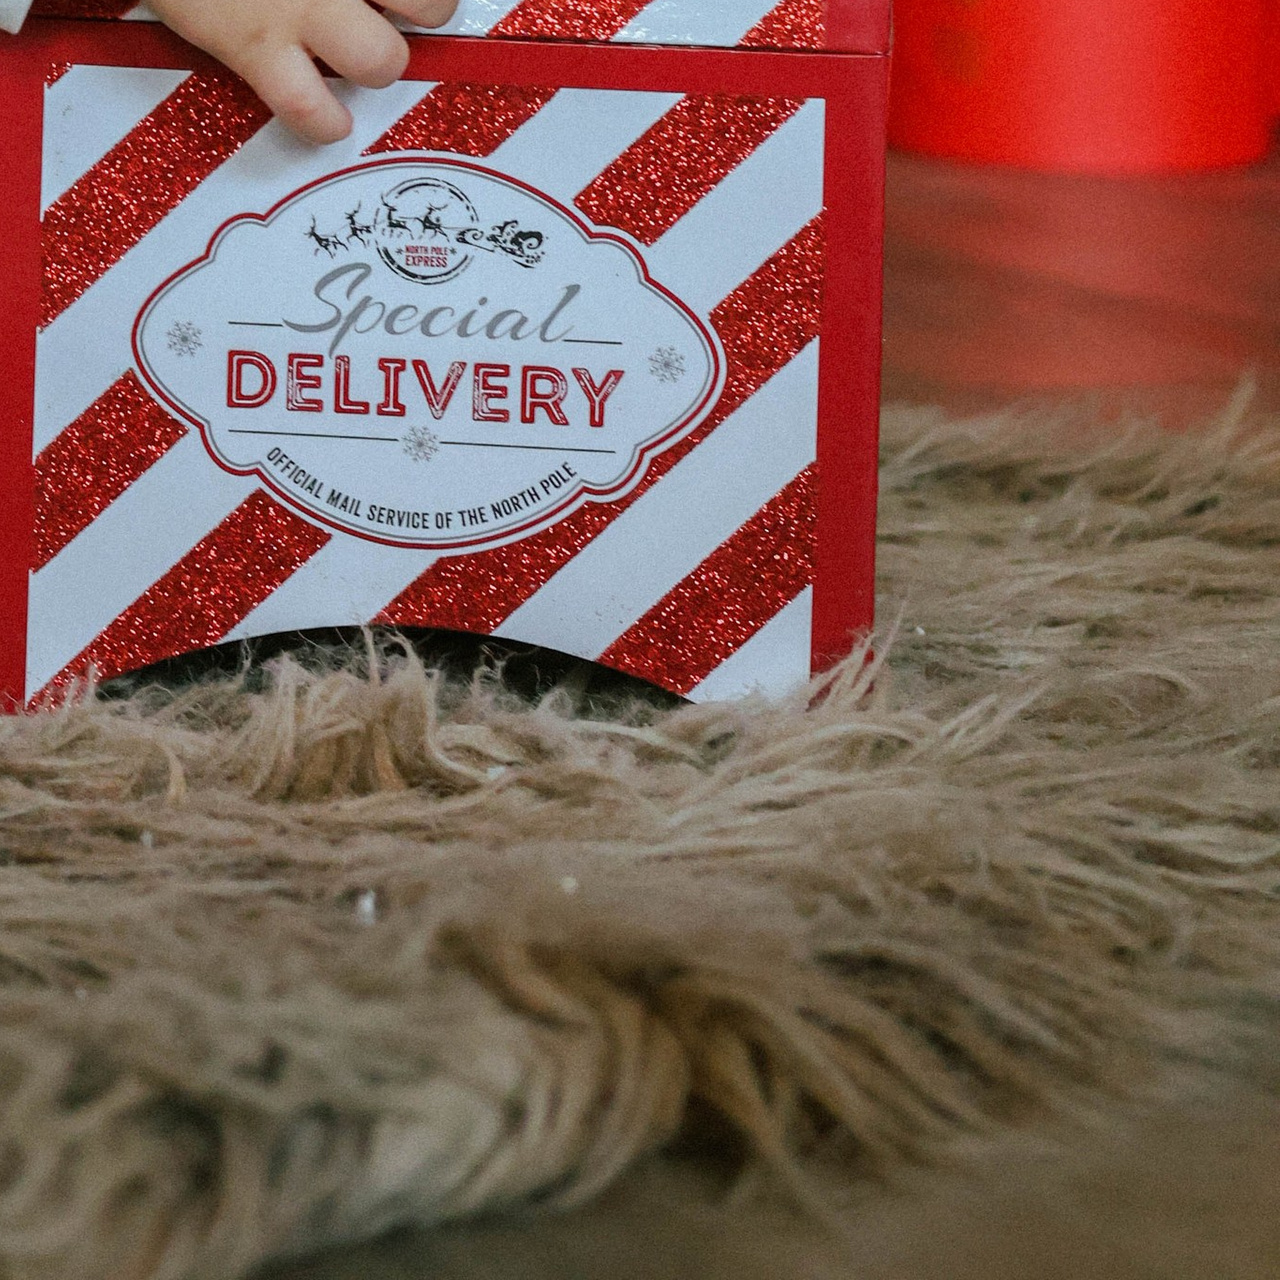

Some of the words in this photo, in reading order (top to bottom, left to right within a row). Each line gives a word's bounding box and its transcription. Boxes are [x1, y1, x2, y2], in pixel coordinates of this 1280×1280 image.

[405, 245, 428, 254] NORTH
[431, 246, 448, 255] POLE
[405, 255, 448, 267] EXPRESS
[282, 262, 581, 359] Special
[226, 349, 625, 428] DELIVERY
[266, 446, 324, 499] OFFICIAL
[326, 488, 361, 517] MAIL
[367, 505, 429, 529] SERVICE
[435, 513, 452, 529] OF
[459, 506, 489, 527] THE
[490, 486, 541, 519] NORTH
[542, 461, 578, 496] POLE
